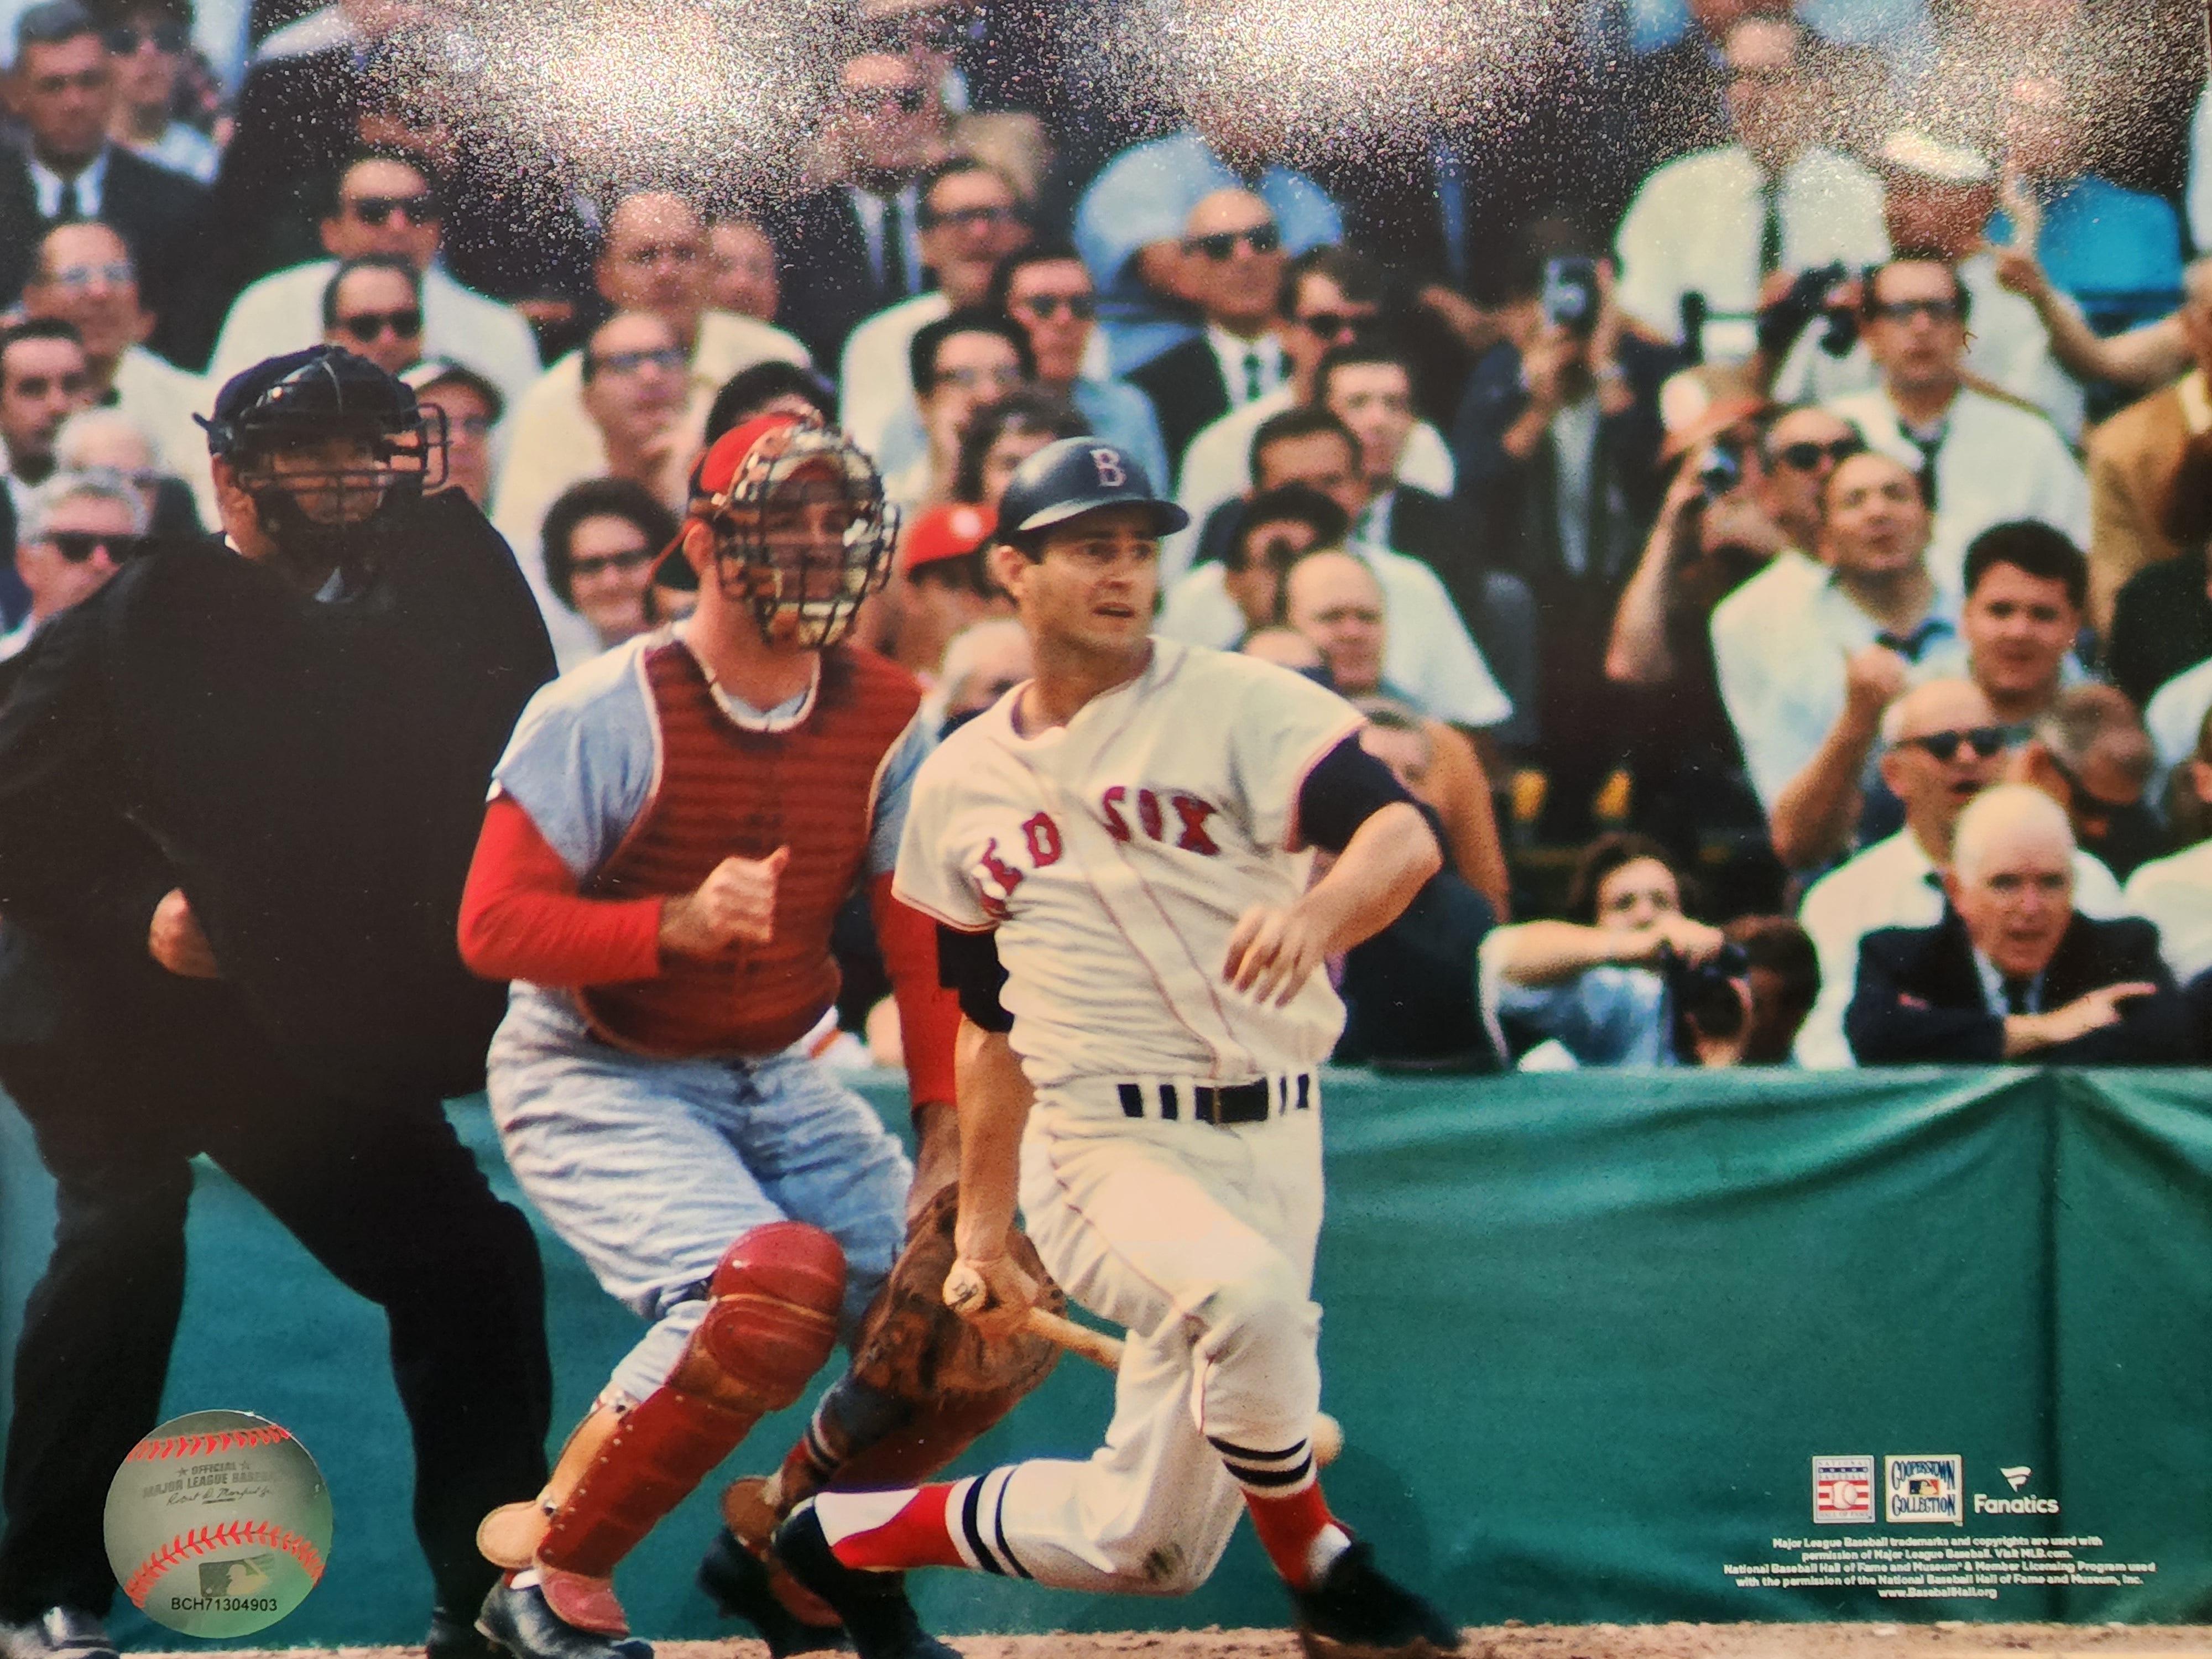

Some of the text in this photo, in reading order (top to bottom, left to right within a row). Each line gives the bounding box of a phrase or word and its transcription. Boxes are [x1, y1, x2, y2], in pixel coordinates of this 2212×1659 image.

[1089, 448, 1126, 487] B
[1102, 785, 1220, 857] SOX
[191, 1461, 237, 1475] OFFICIAL
[142, 1479, 184, 1499] MAJOR
[187, 1472, 228, 1489] LEAGUE
[1891, 1494, 1956, 1517] COLLECTION
[1974, 1493, 2059, 1514] Fanatics
[1772, 1538, 1802, 1550] Major
[1803, 1538, 1843, 1550] League
[1844, 1537, 1888, 1547] Baseball
[1950, 1536, 1971, 1546] and
[2031, 1537, 2049, 1546] are
[2078, 1536, 2103, 1546] with
[1860, 1550, 1872, 1559] of
[1724, 1563, 1770, 1574] National
[1771, 1563, 1818, 1574] Baseball
[1819, 1562, 1841, 1573] Hall
[1843, 1562, 1856, 1573] of
[1856, 1562, 1888, 1572] Fame
[1890, 1562, 1912, 1572] and
[2127, 1562, 2156, 1572] used
[1735, 1577, 1760, 1587] with
[1761, 1577, 1781, 1587] the
[1844, 1575, 1856, 1585] of
[1857, 1575, 1877, 1585] the
[1877, 1574, 1924, 1585] National
[1927, 1574, 1974, 1585] Baseball
[1975, 1573, 1997, 1584] Hall
[1999, 1574, 2012, 1584] of
[2013, 1573, 2046, 1584] Fame
[2047, 1574, 2069, 1584] and
[171, 1597, 278, 1612] BCH71304903
